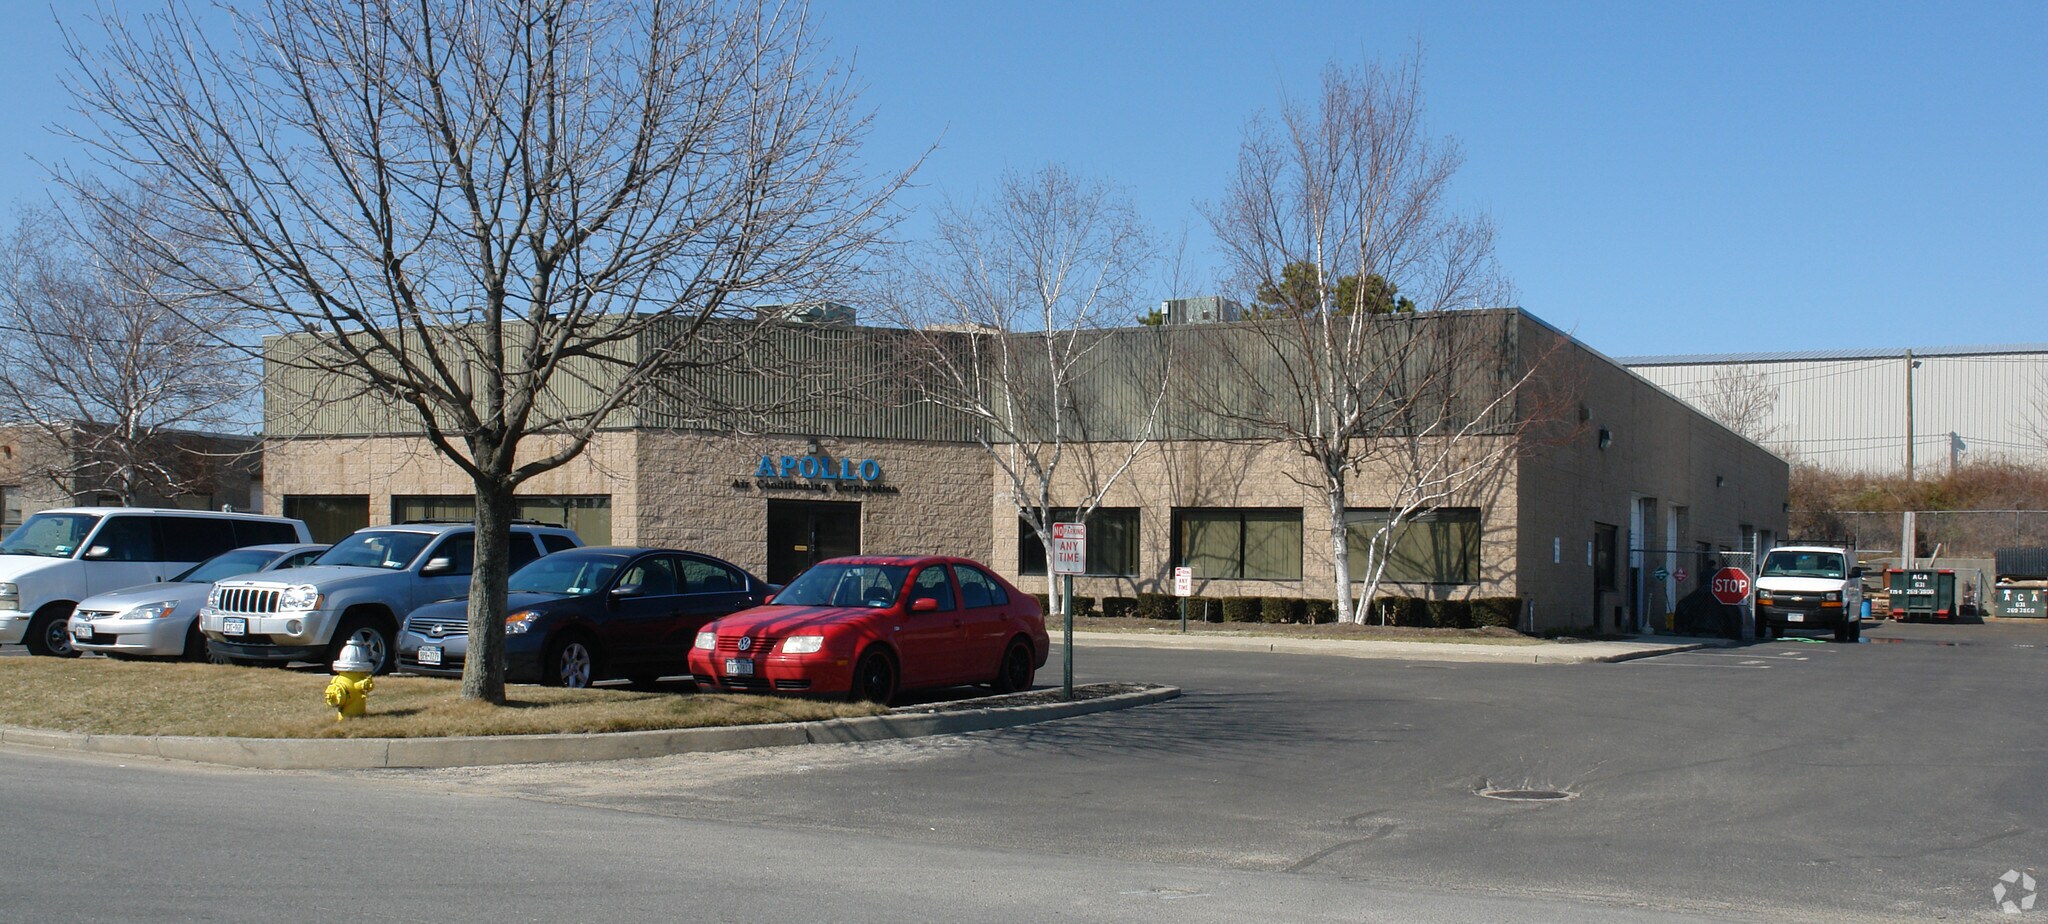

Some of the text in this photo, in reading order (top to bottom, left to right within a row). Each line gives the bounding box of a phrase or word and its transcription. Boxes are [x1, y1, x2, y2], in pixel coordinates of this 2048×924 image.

[754, 455, 880, 481] APOLLO
[732, 479, 899, 494] Air Conditioning Corporation
[1054, 526, 1064, 536] NO
[1060, 541, 1078, 551] ANY
[1059, 552, 1079, 562] TIME
[1715, 578, 1747, 593] STOP
